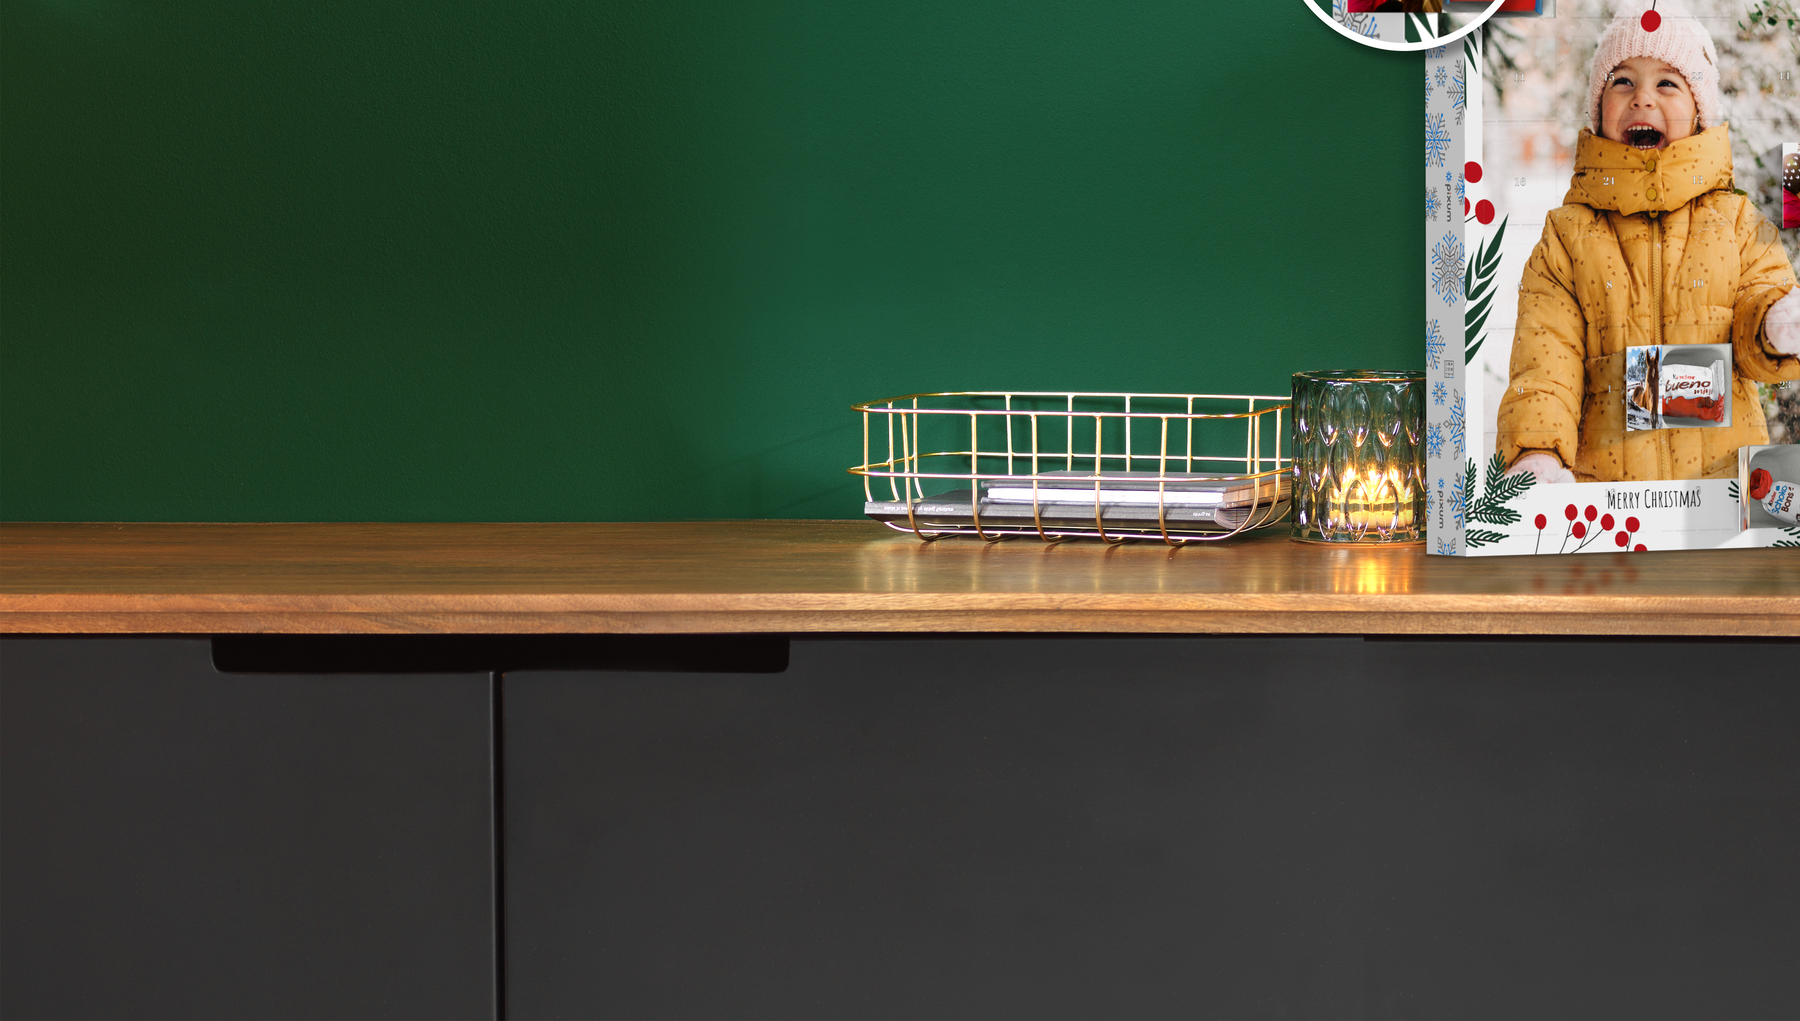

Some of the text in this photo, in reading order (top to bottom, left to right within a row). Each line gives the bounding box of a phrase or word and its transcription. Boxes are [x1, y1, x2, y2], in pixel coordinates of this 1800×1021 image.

[1514, 73, 1525, 82] 11
[1604, 72, 1615, 81] 15
[1691, 72, 1703, 81] 22
[1514, 177, 1526, 187] 16
[1603, 176, 1615, 186] 24
[1692, 175, 1704, 185] 13
[1606, 280, 1613, 289] 8
[1692, 279, 1704, 288] 10
[1782, 277, 1788, 286] 7
[1665, 379, 1711, 392] bueno
[1517, 386, 1524, 395] 9
[1780, 492, 1795, 513] Bons
